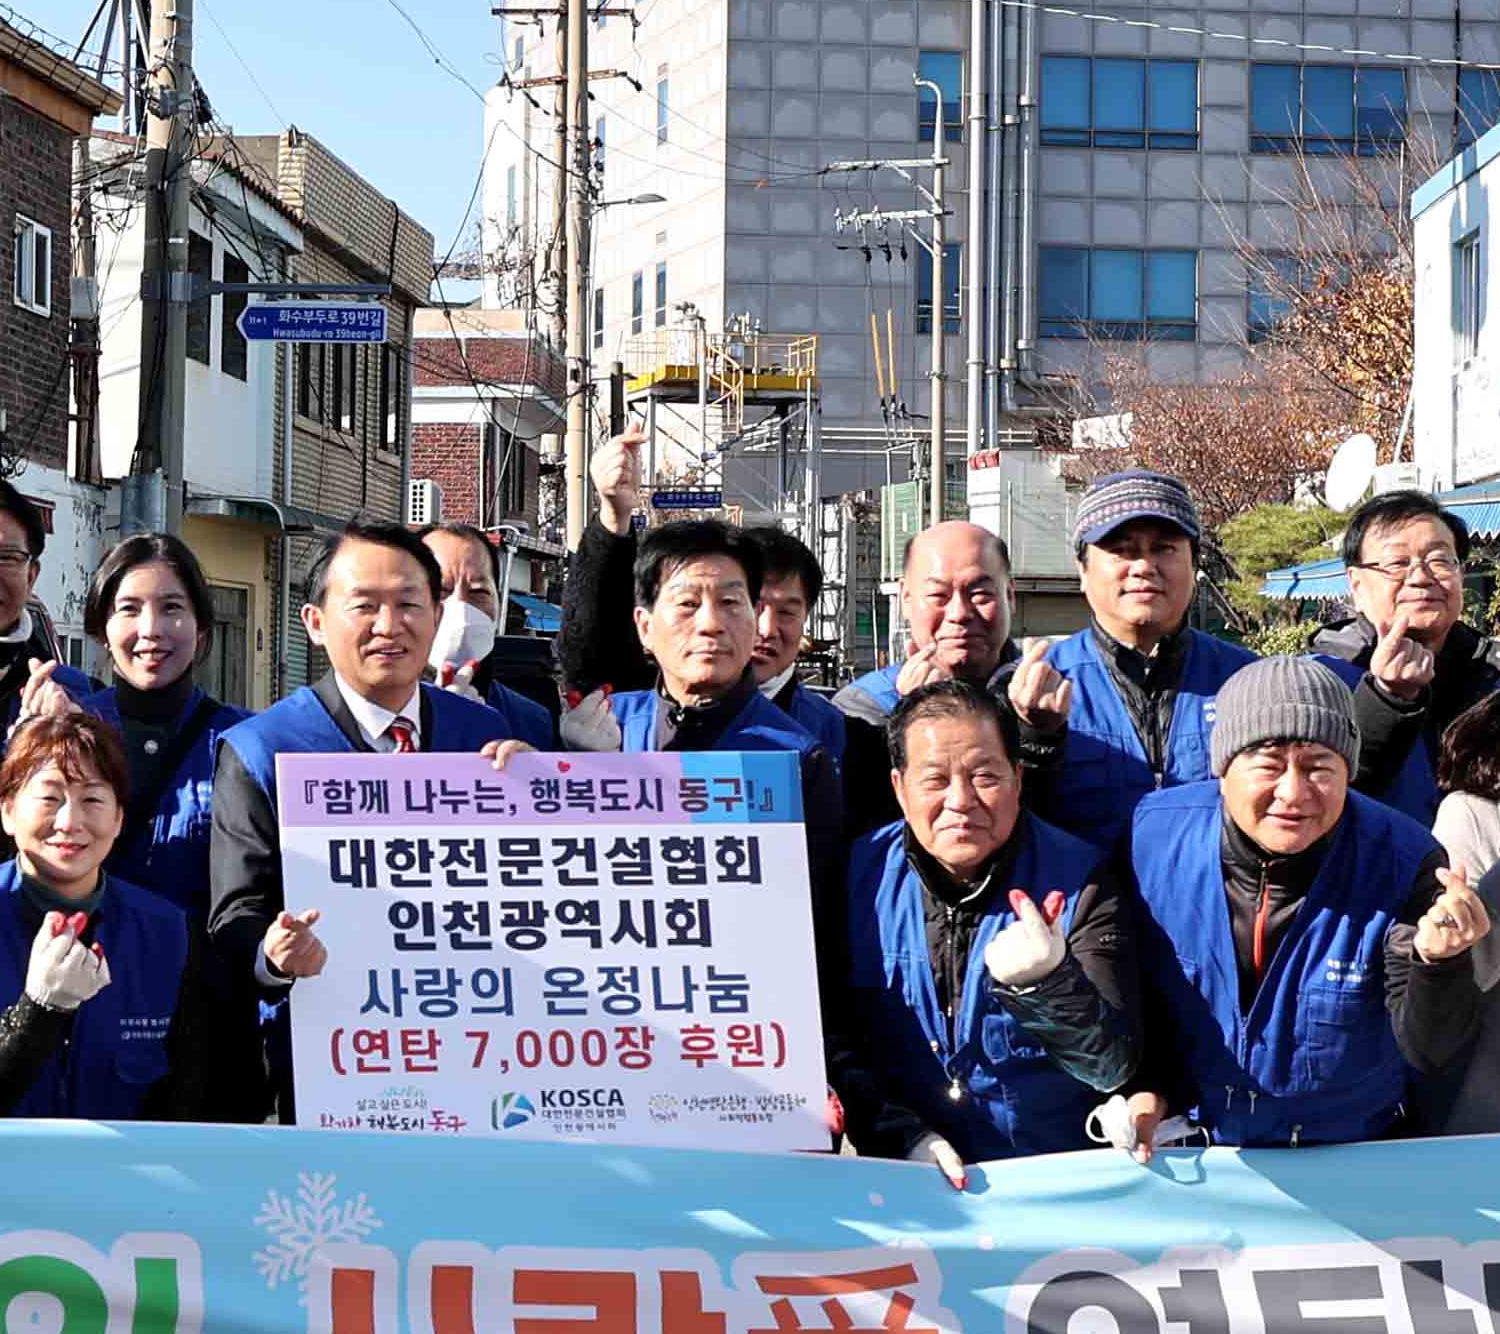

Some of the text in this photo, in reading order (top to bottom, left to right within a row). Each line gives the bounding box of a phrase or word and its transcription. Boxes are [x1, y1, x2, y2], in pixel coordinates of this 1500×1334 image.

[404, 779, 517, 816] 나누는,
[529, 777, 664, 814] 행복도시
[329, 835, 762, 889] 대한전문건설협회
[388, 898, 713, 951] 인천광역시회
[360, 965, 750, 1018] 사랑의 온정나눔
[331, 1021, 787, 1075] (연탄 7,000장 후원)
[540, 1088, 625, 1107] KOSCA
